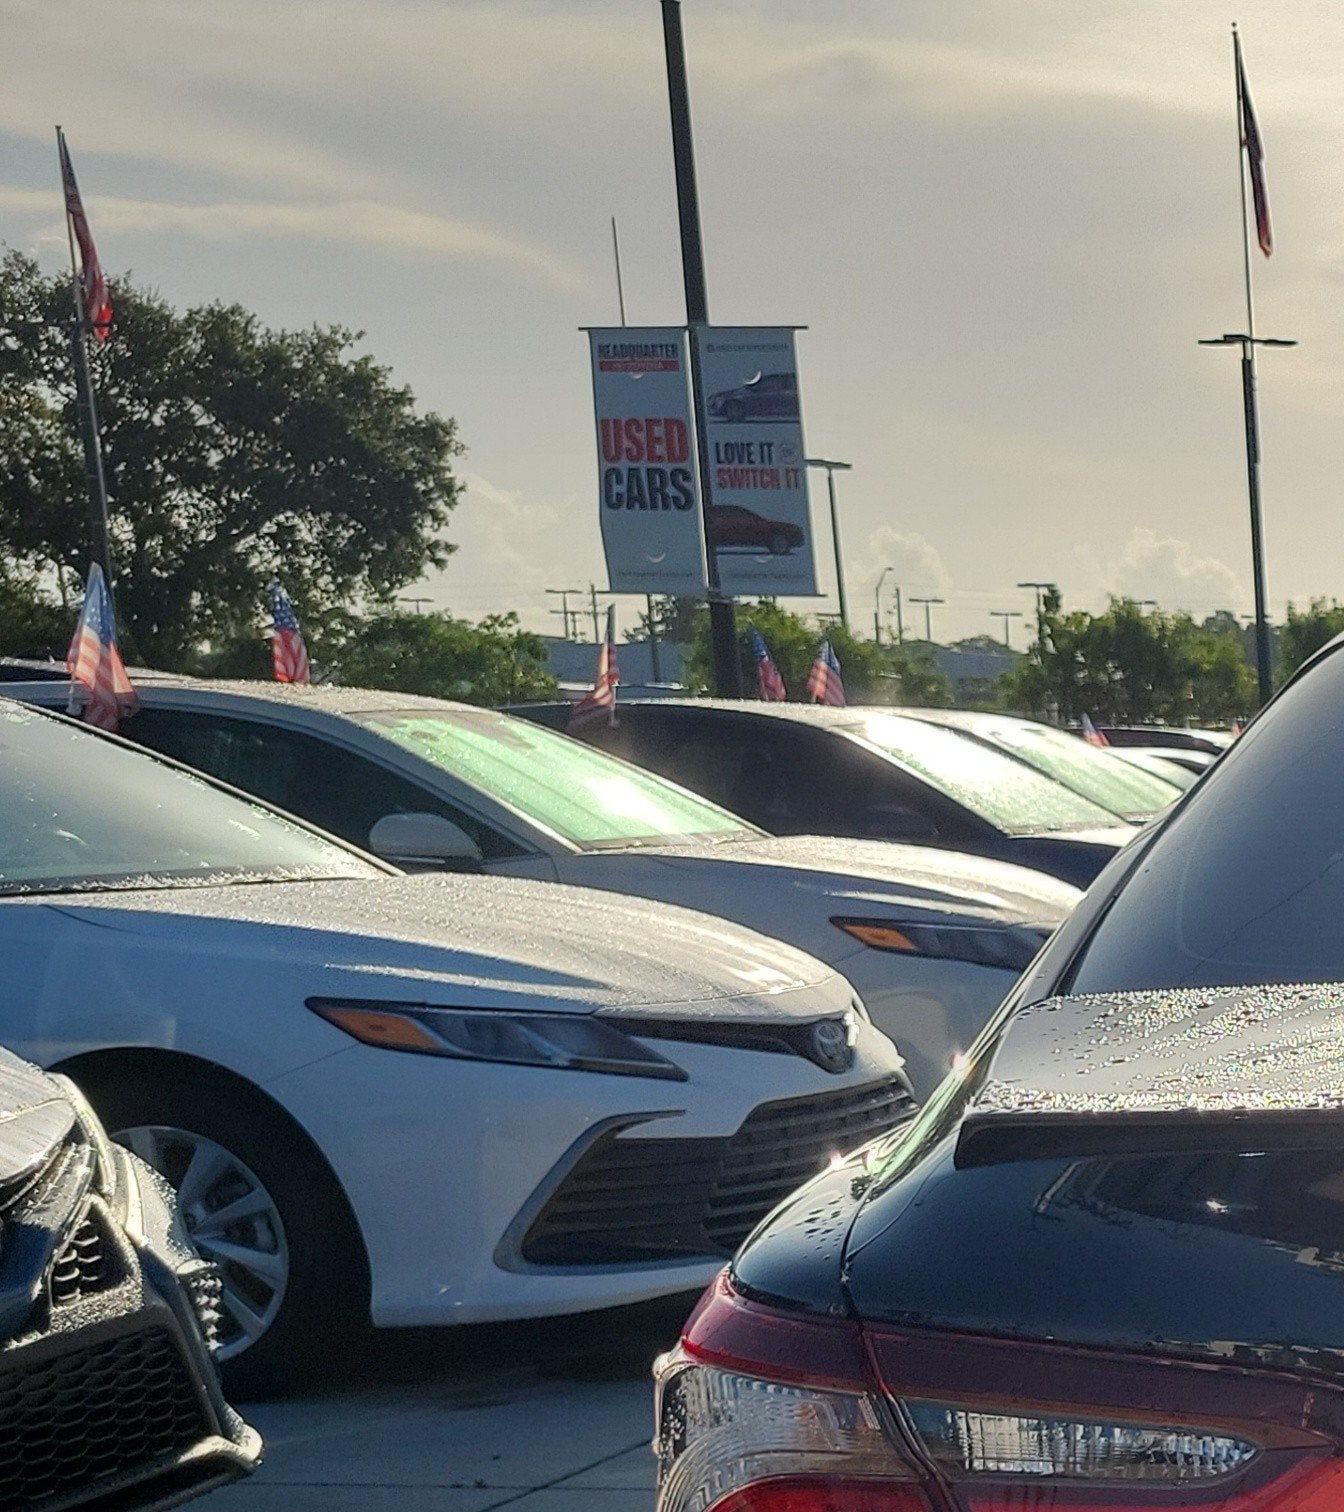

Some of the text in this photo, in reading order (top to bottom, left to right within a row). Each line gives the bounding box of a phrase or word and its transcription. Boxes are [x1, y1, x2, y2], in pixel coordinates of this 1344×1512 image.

[601, 417, 689, 464] USED
[714, 442, 774, 464] LOVE IT
[604, 467, 694, 512] CARS
[717, 468, 799, 490] SWITCH IT
